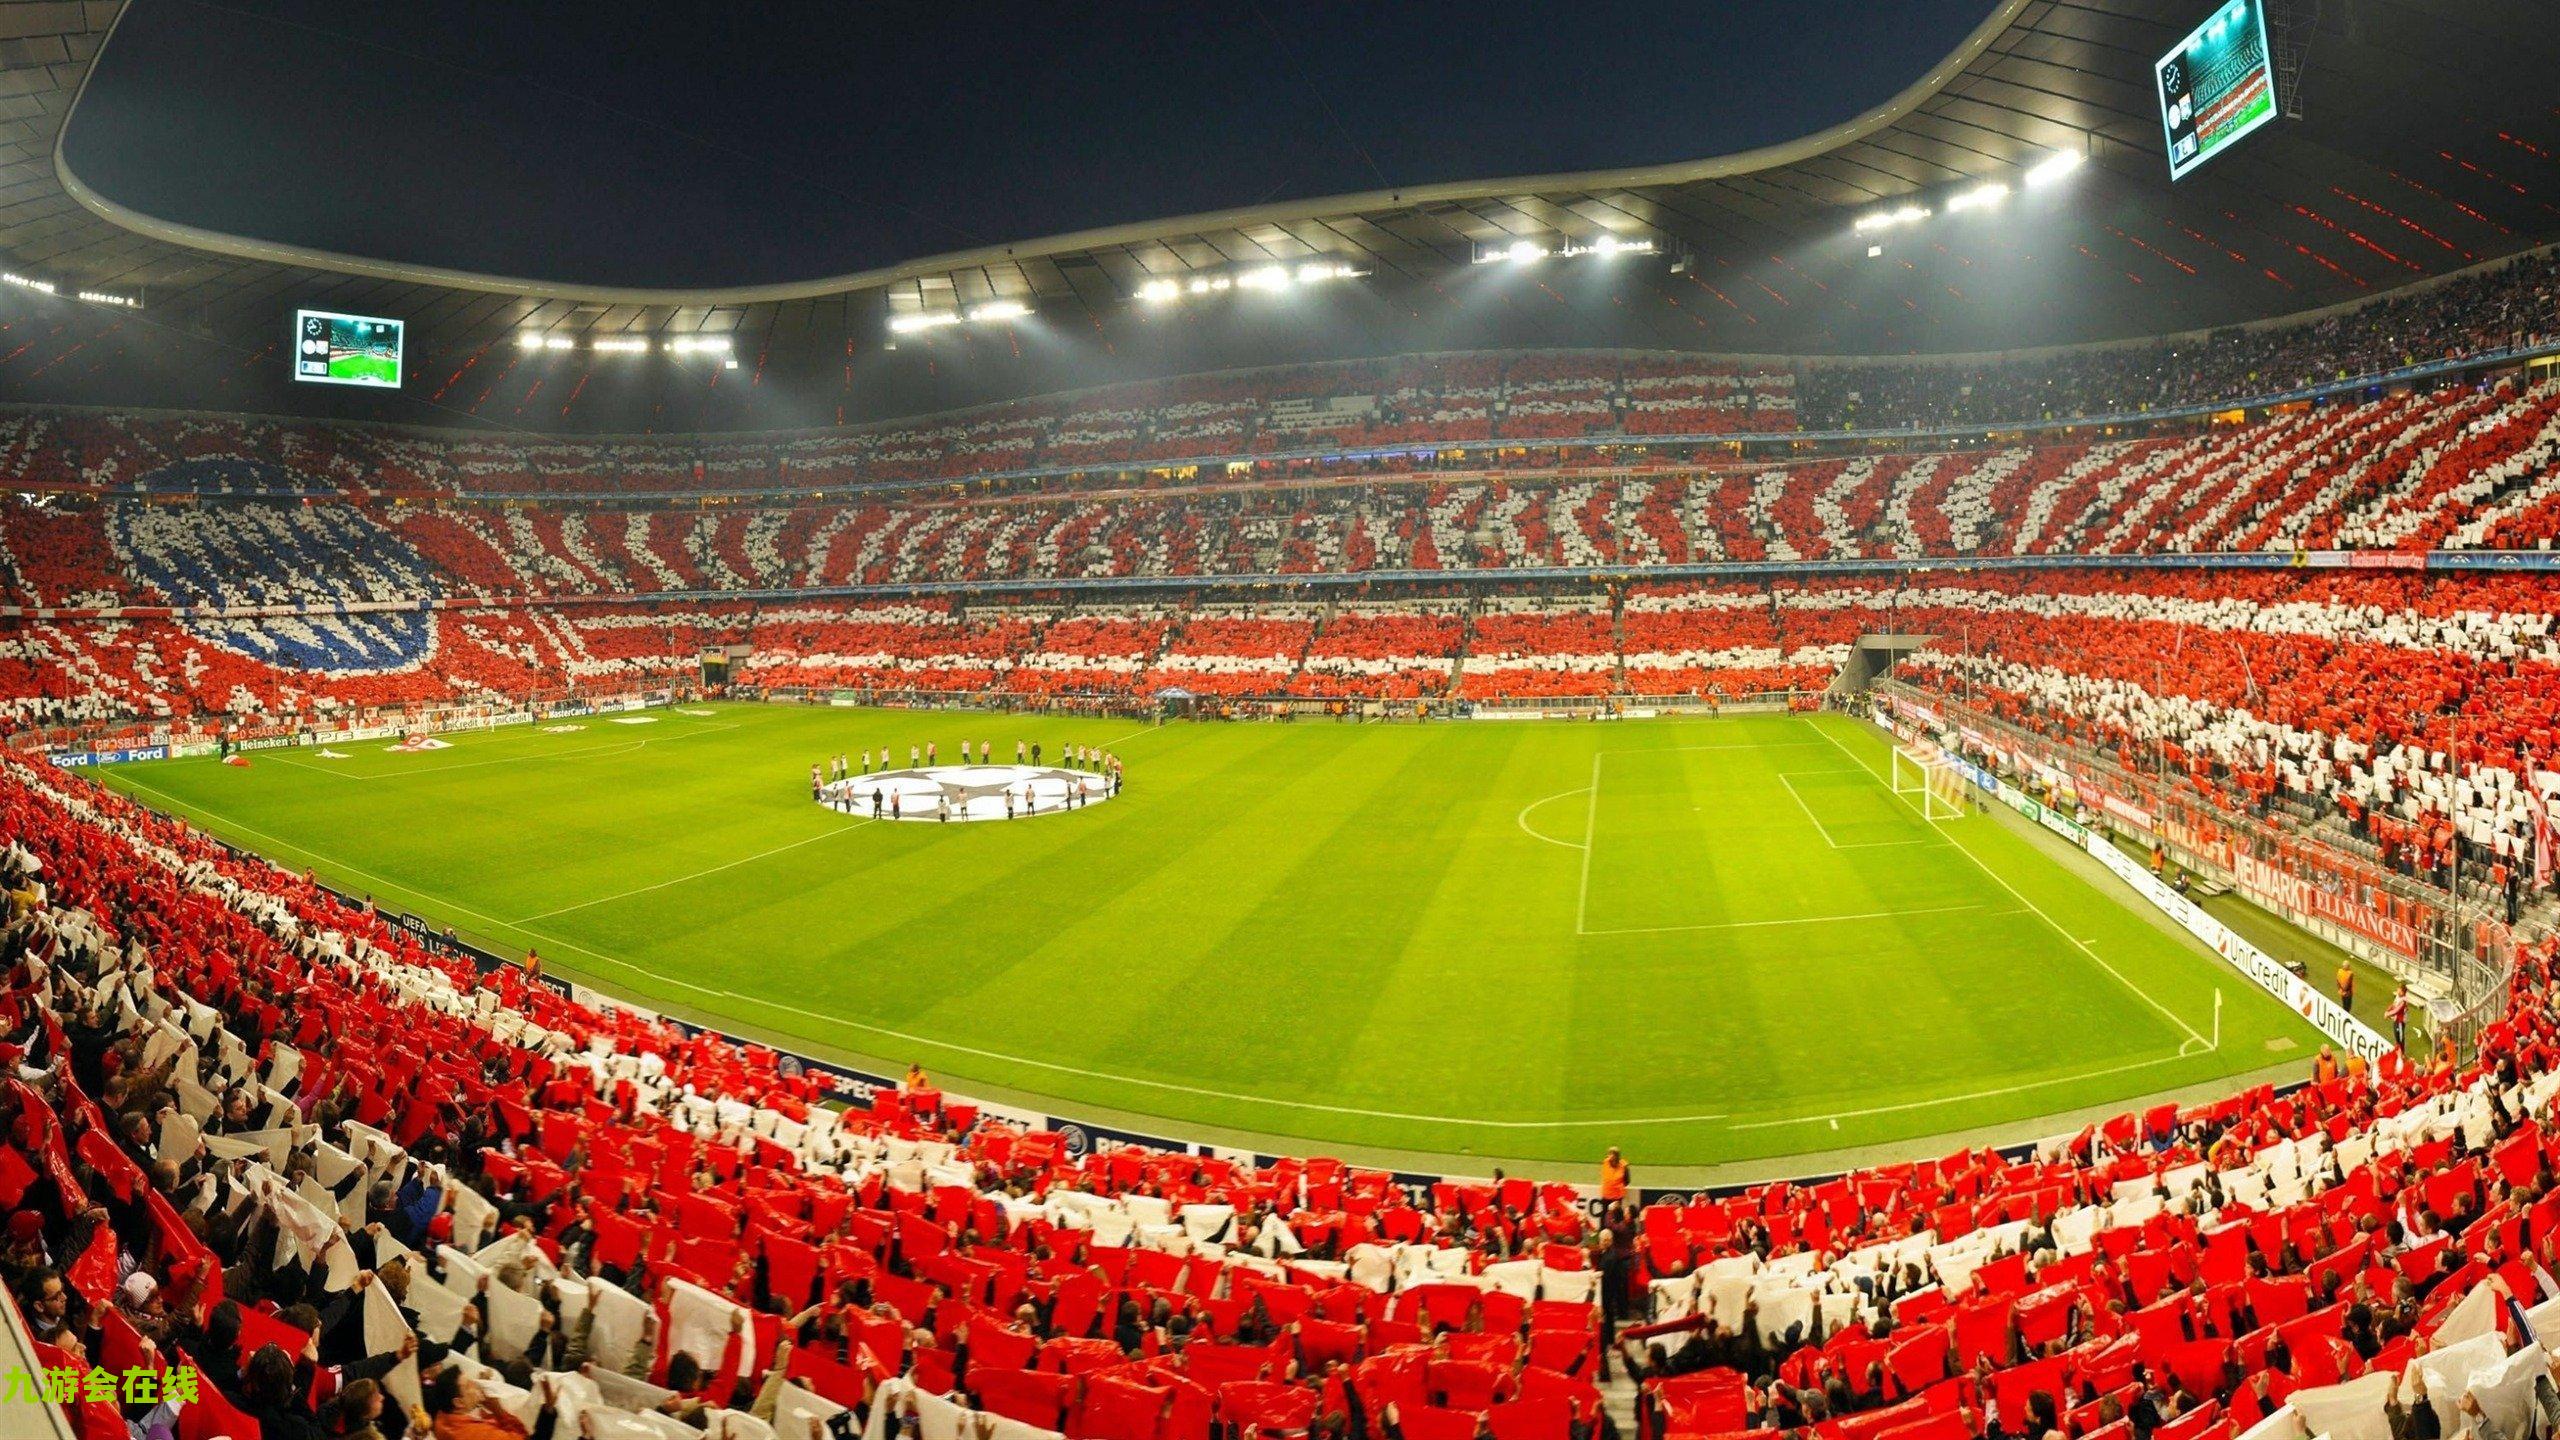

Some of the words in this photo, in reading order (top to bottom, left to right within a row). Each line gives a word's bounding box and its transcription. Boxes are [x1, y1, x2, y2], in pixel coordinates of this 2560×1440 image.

[128, 748, 163, 761] Ford
[240, 739, 288, 750] Heineken
[51, 754, 88, 767] Ford
[2233, 851, 2312, 916] NEUMARKT
[403, 915, 427, 935] UEFA
[2315, 891, 2417, 949] ELLWANGEN
[2230, 936, 2289, 1002] UniCredit
